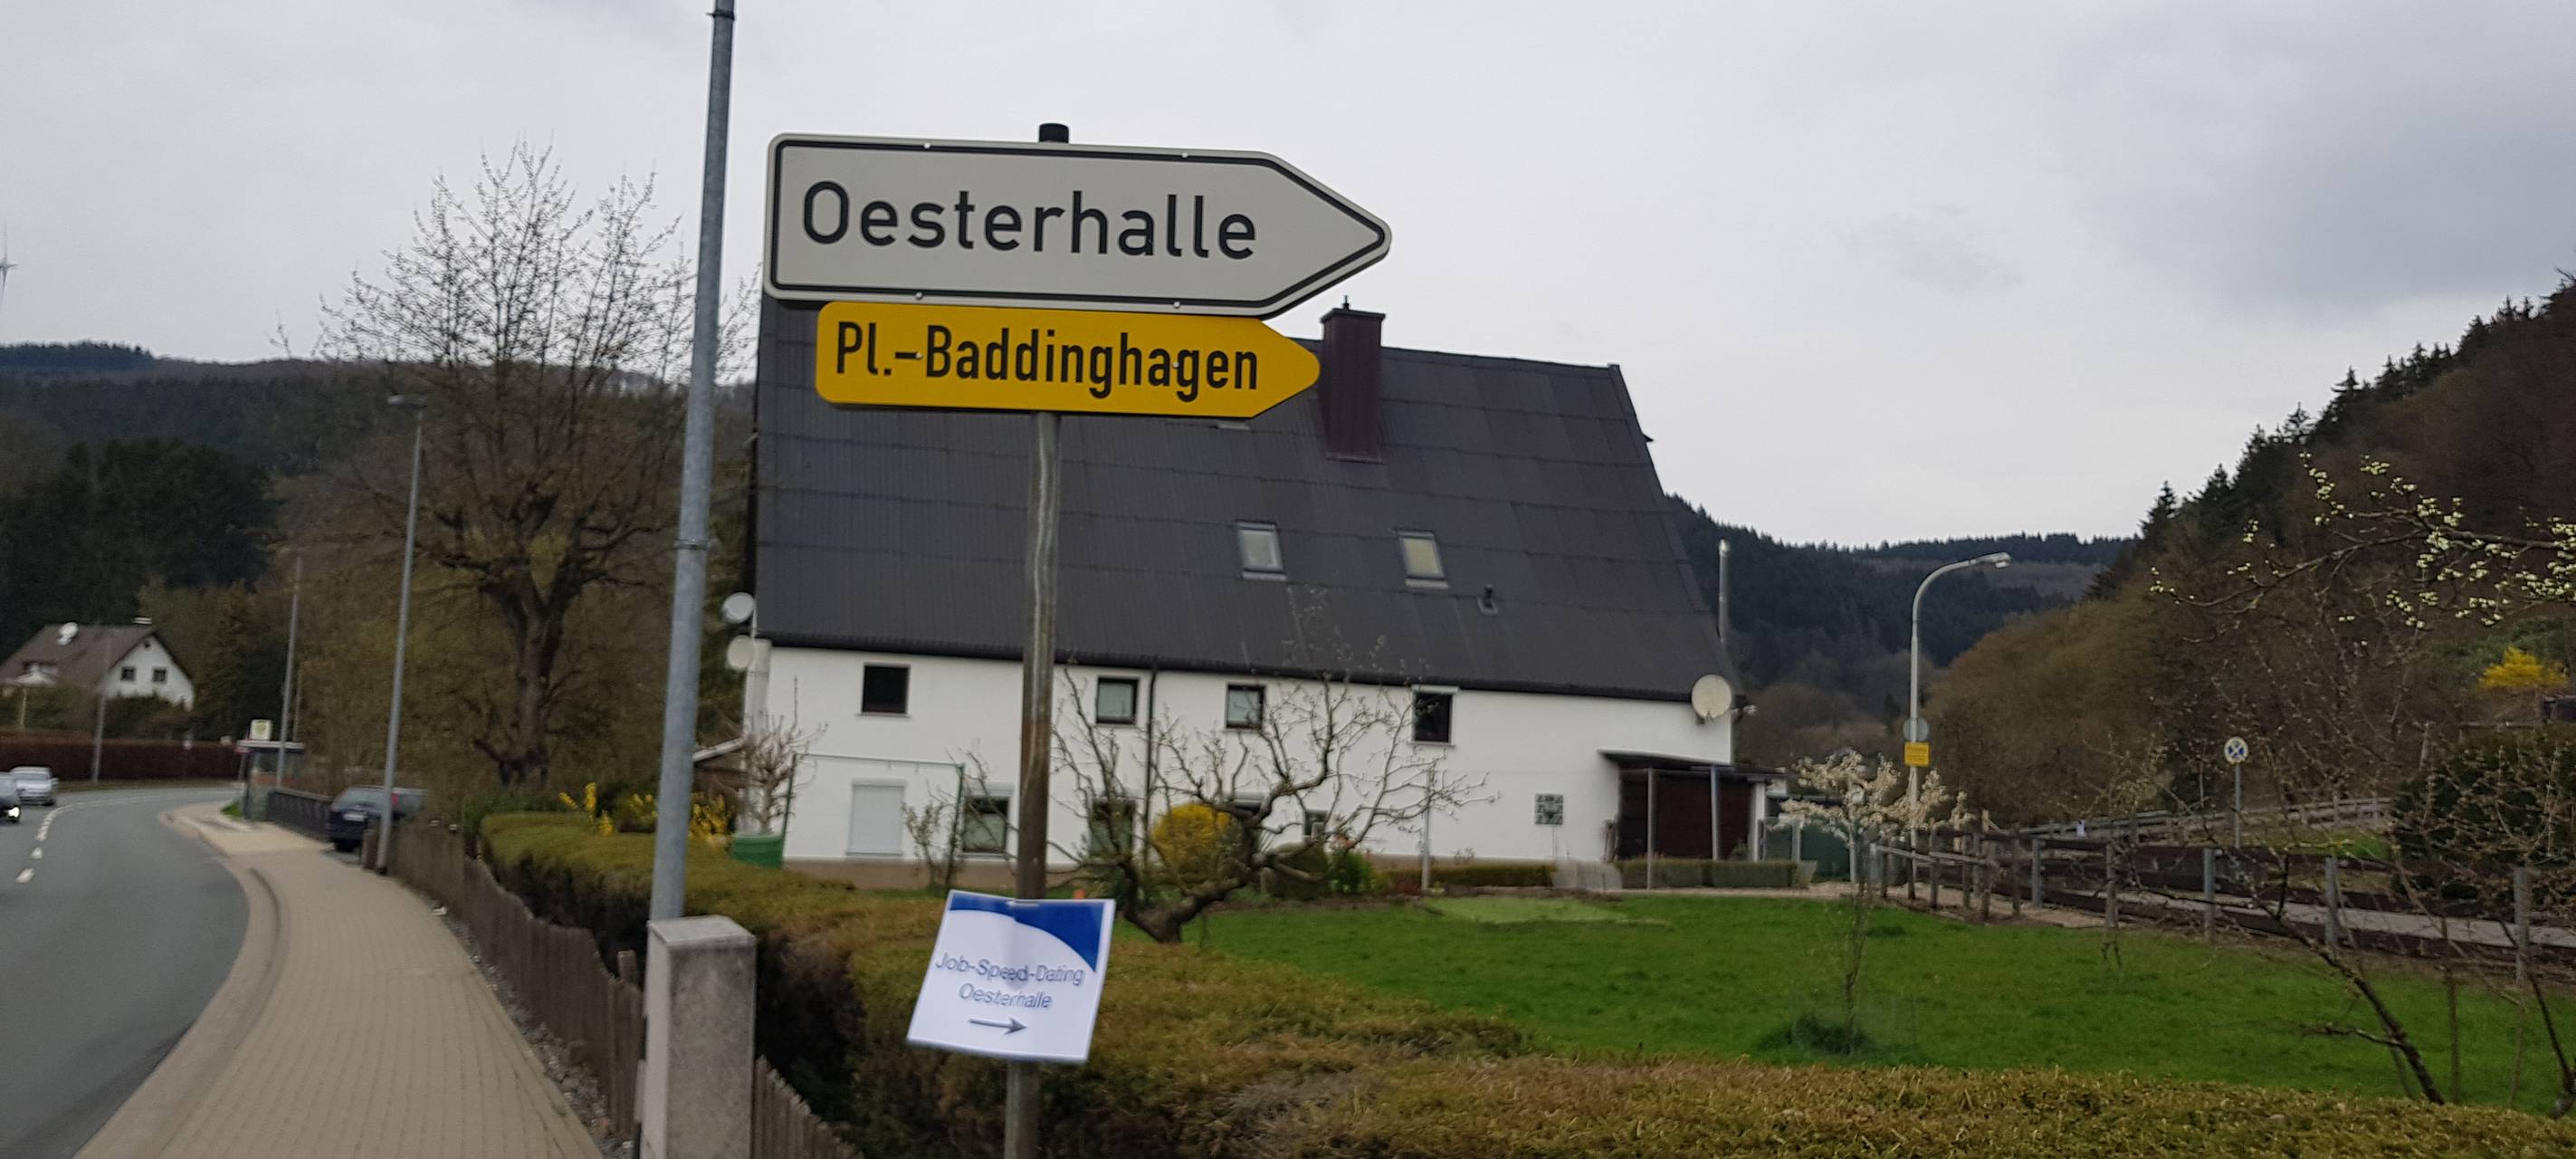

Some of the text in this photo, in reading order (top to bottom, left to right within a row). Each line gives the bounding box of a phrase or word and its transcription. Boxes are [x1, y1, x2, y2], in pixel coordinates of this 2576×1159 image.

[804, 180, 1256, 259] Oesterhalle
[835, 321, 1258, 402] Pl.-Baddinghagen
[936, 953, 1084, 985] Job-Speed-Dating
[959, 983, 1052, 1008] Oesterhalle
